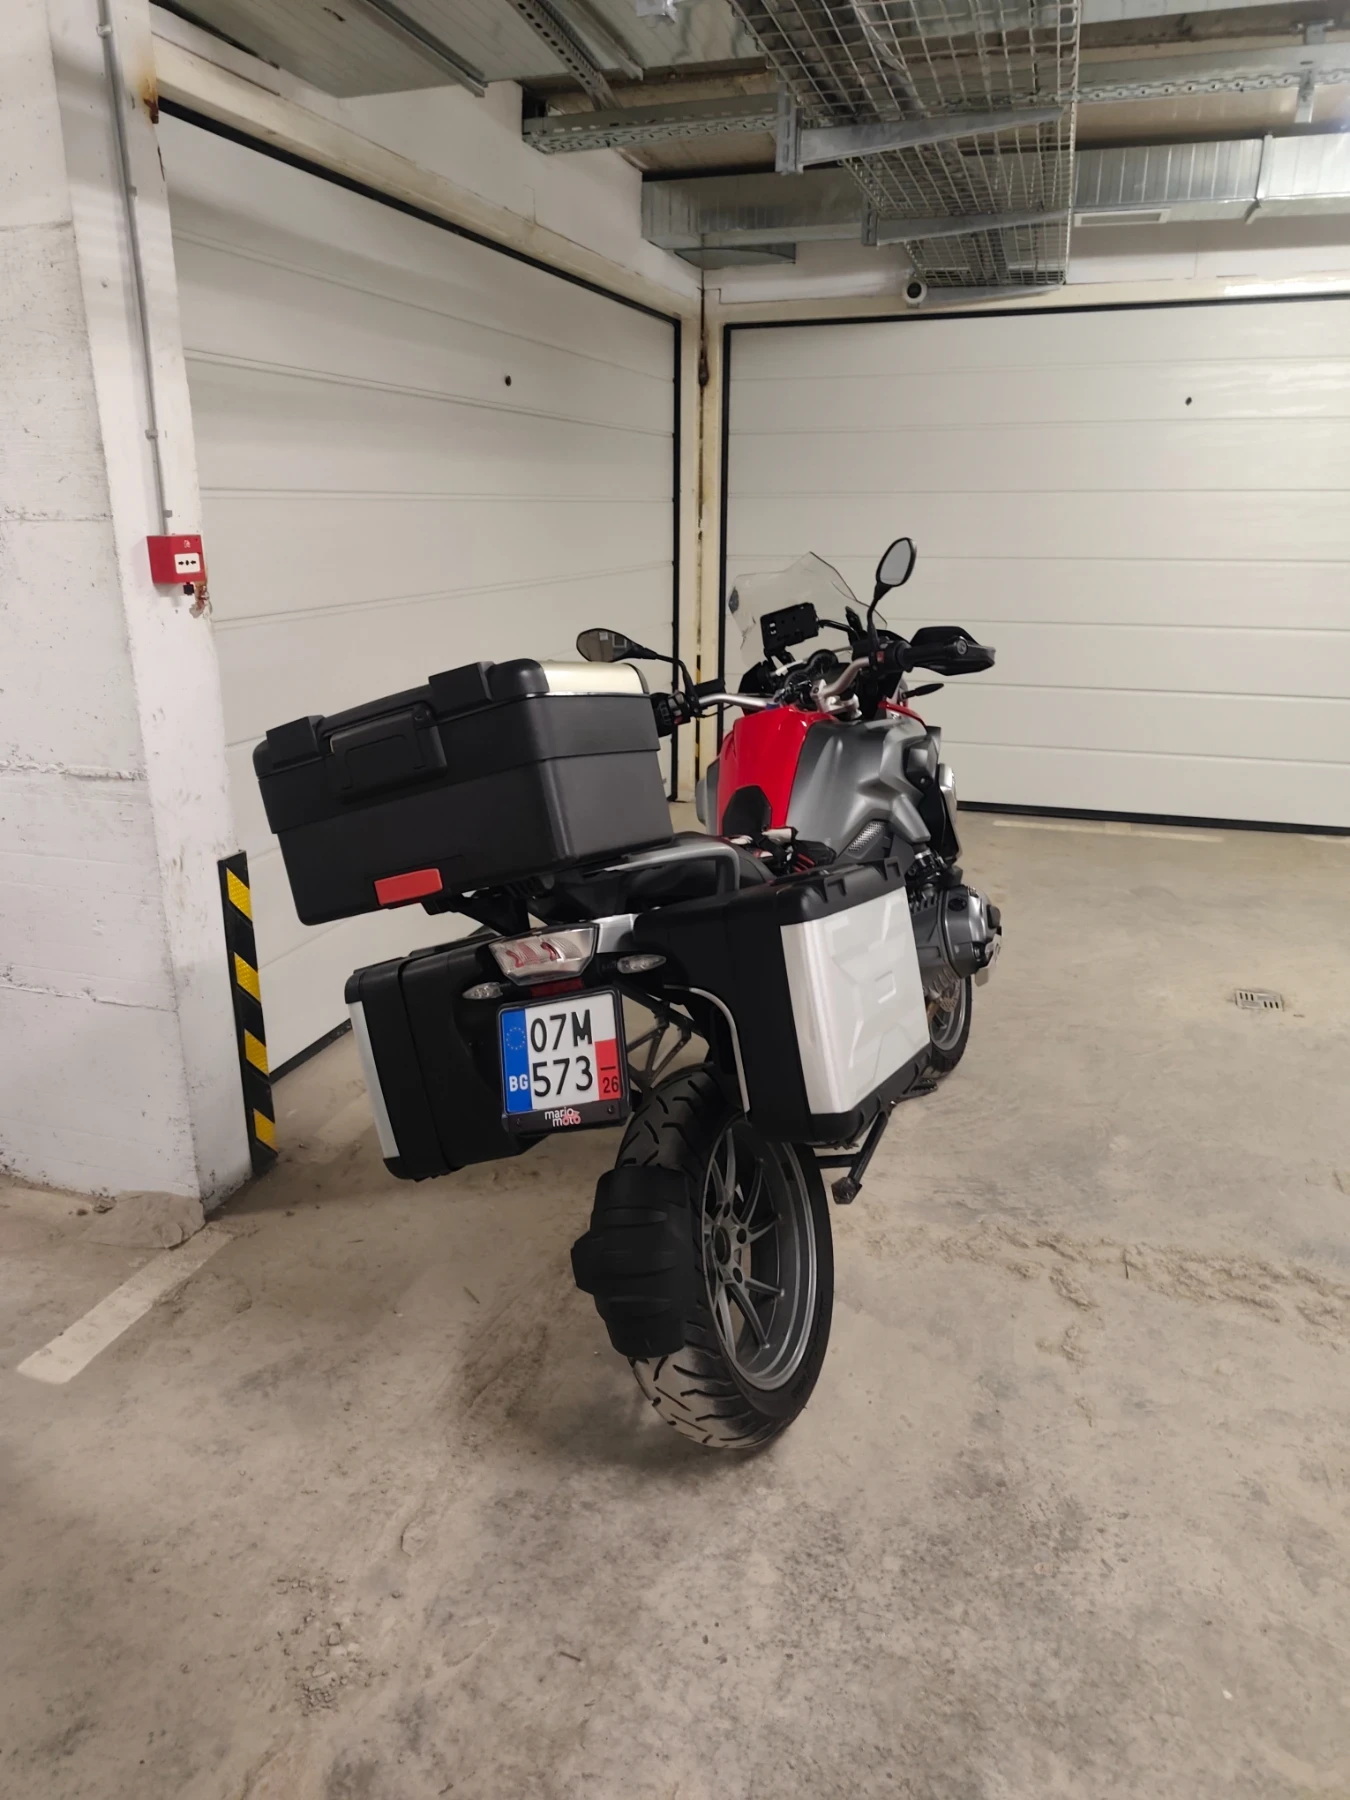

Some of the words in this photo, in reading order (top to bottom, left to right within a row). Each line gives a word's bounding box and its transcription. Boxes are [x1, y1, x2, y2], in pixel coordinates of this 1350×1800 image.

[530, 1009, 593, 1053] 07M
[509, 1074, 529, 1092] BG
[532, 1055, 593, 1097] 573
[603, 1076, 619, 1093] 26
[545, 1107, 574, 1120] mario
[552, 1114, 581, 1127] moto
